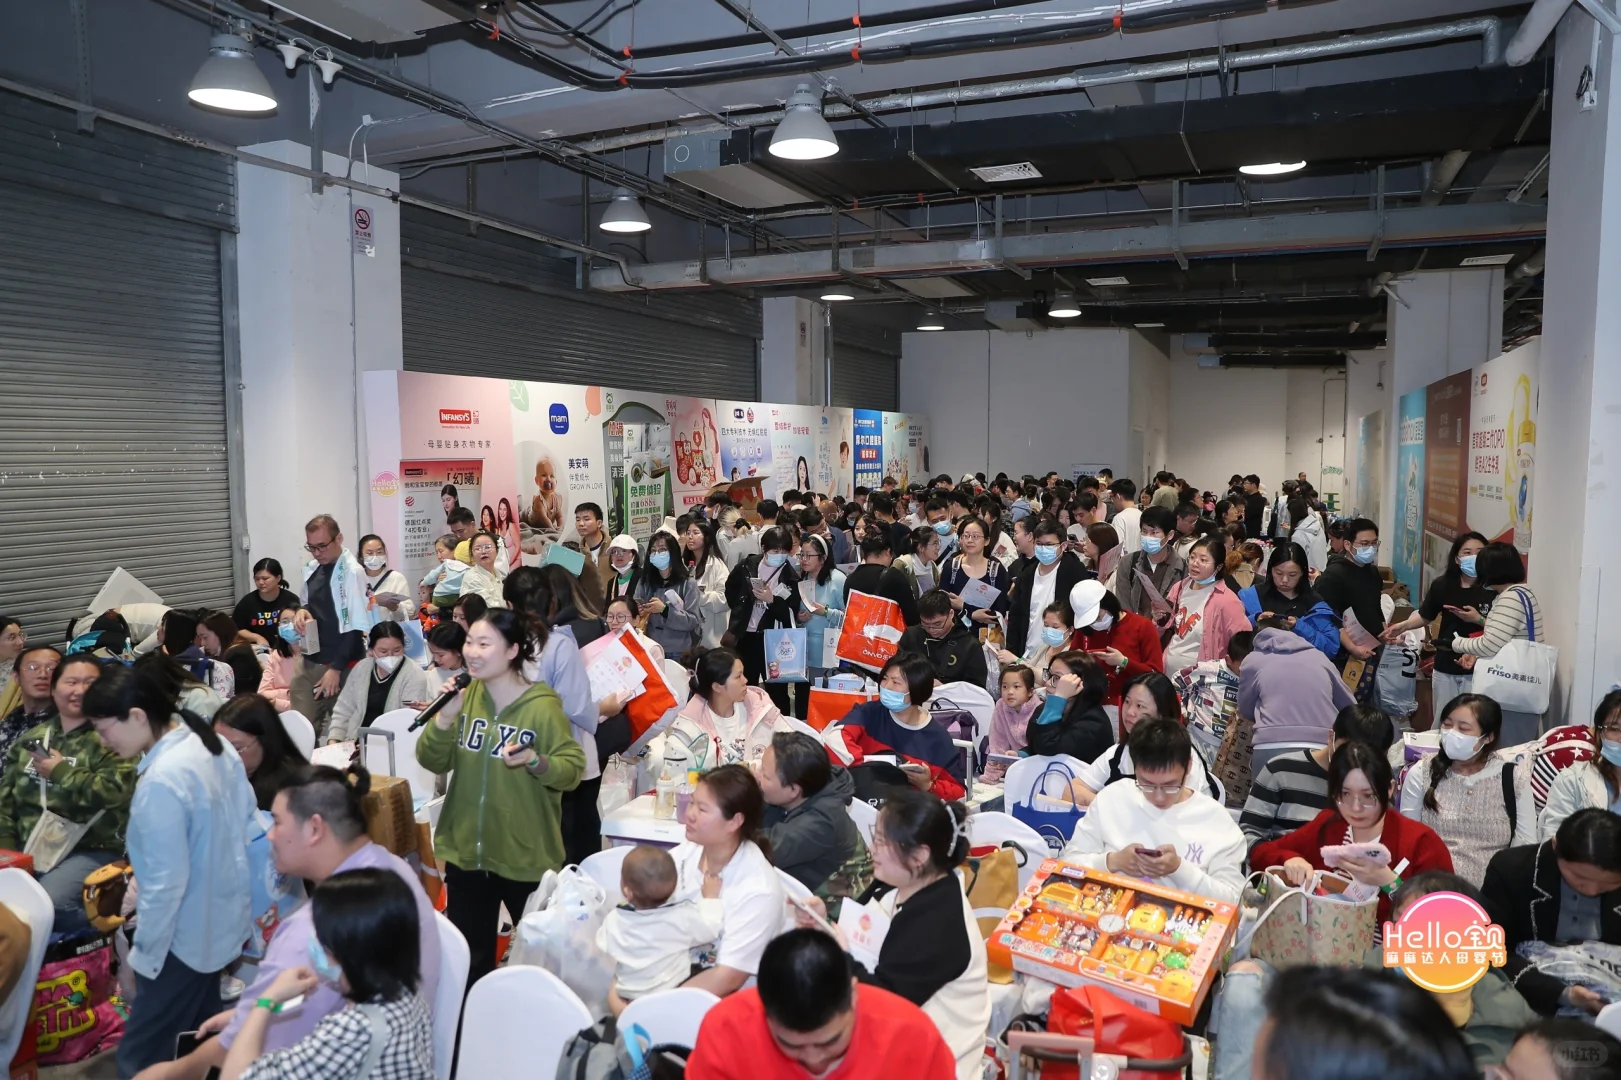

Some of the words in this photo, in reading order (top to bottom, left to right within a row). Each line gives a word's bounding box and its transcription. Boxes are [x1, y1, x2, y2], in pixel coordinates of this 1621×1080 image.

[551, 415, 567, 423] mam
[428, 440, 491, 449] 母婴贴身衣物专家
[569, 458, 589, 469] 美安萌
[569, 473, 589, 482] 伴爱成长
[630, 484, 661, 497] 免费体验
[1487, 666, 1511, 679] Friso
[1511, 672, 1542, 685] 美素佳儿
